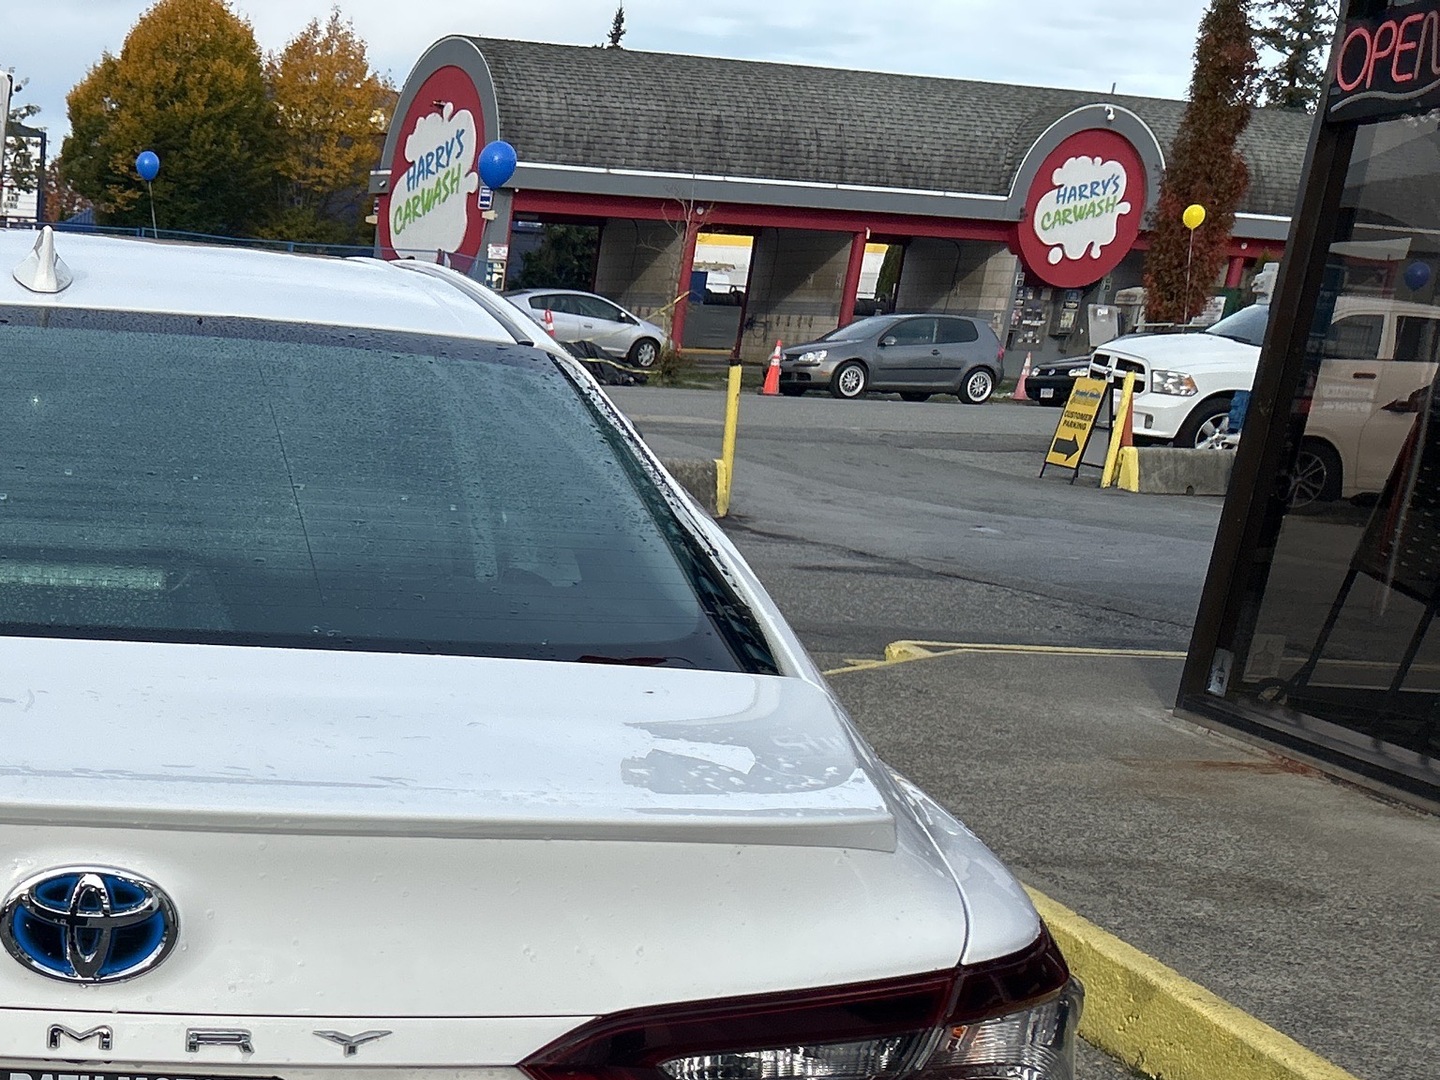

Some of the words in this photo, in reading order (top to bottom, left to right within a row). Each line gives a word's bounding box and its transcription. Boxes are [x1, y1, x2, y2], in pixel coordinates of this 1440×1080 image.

[1337, 10, 1440, 91] OPEN
[406, 128, 465, 192] HARRY'S
[393, 163, 461, 235] CARWASH
[1056, 173, 1120, 204] HARRY'S
[1041, 196, 1117, 231] CARWASH
[1062, 420, 1087, 431] PARKING
[1063, 410, 1093, 421] CUSTOMER
